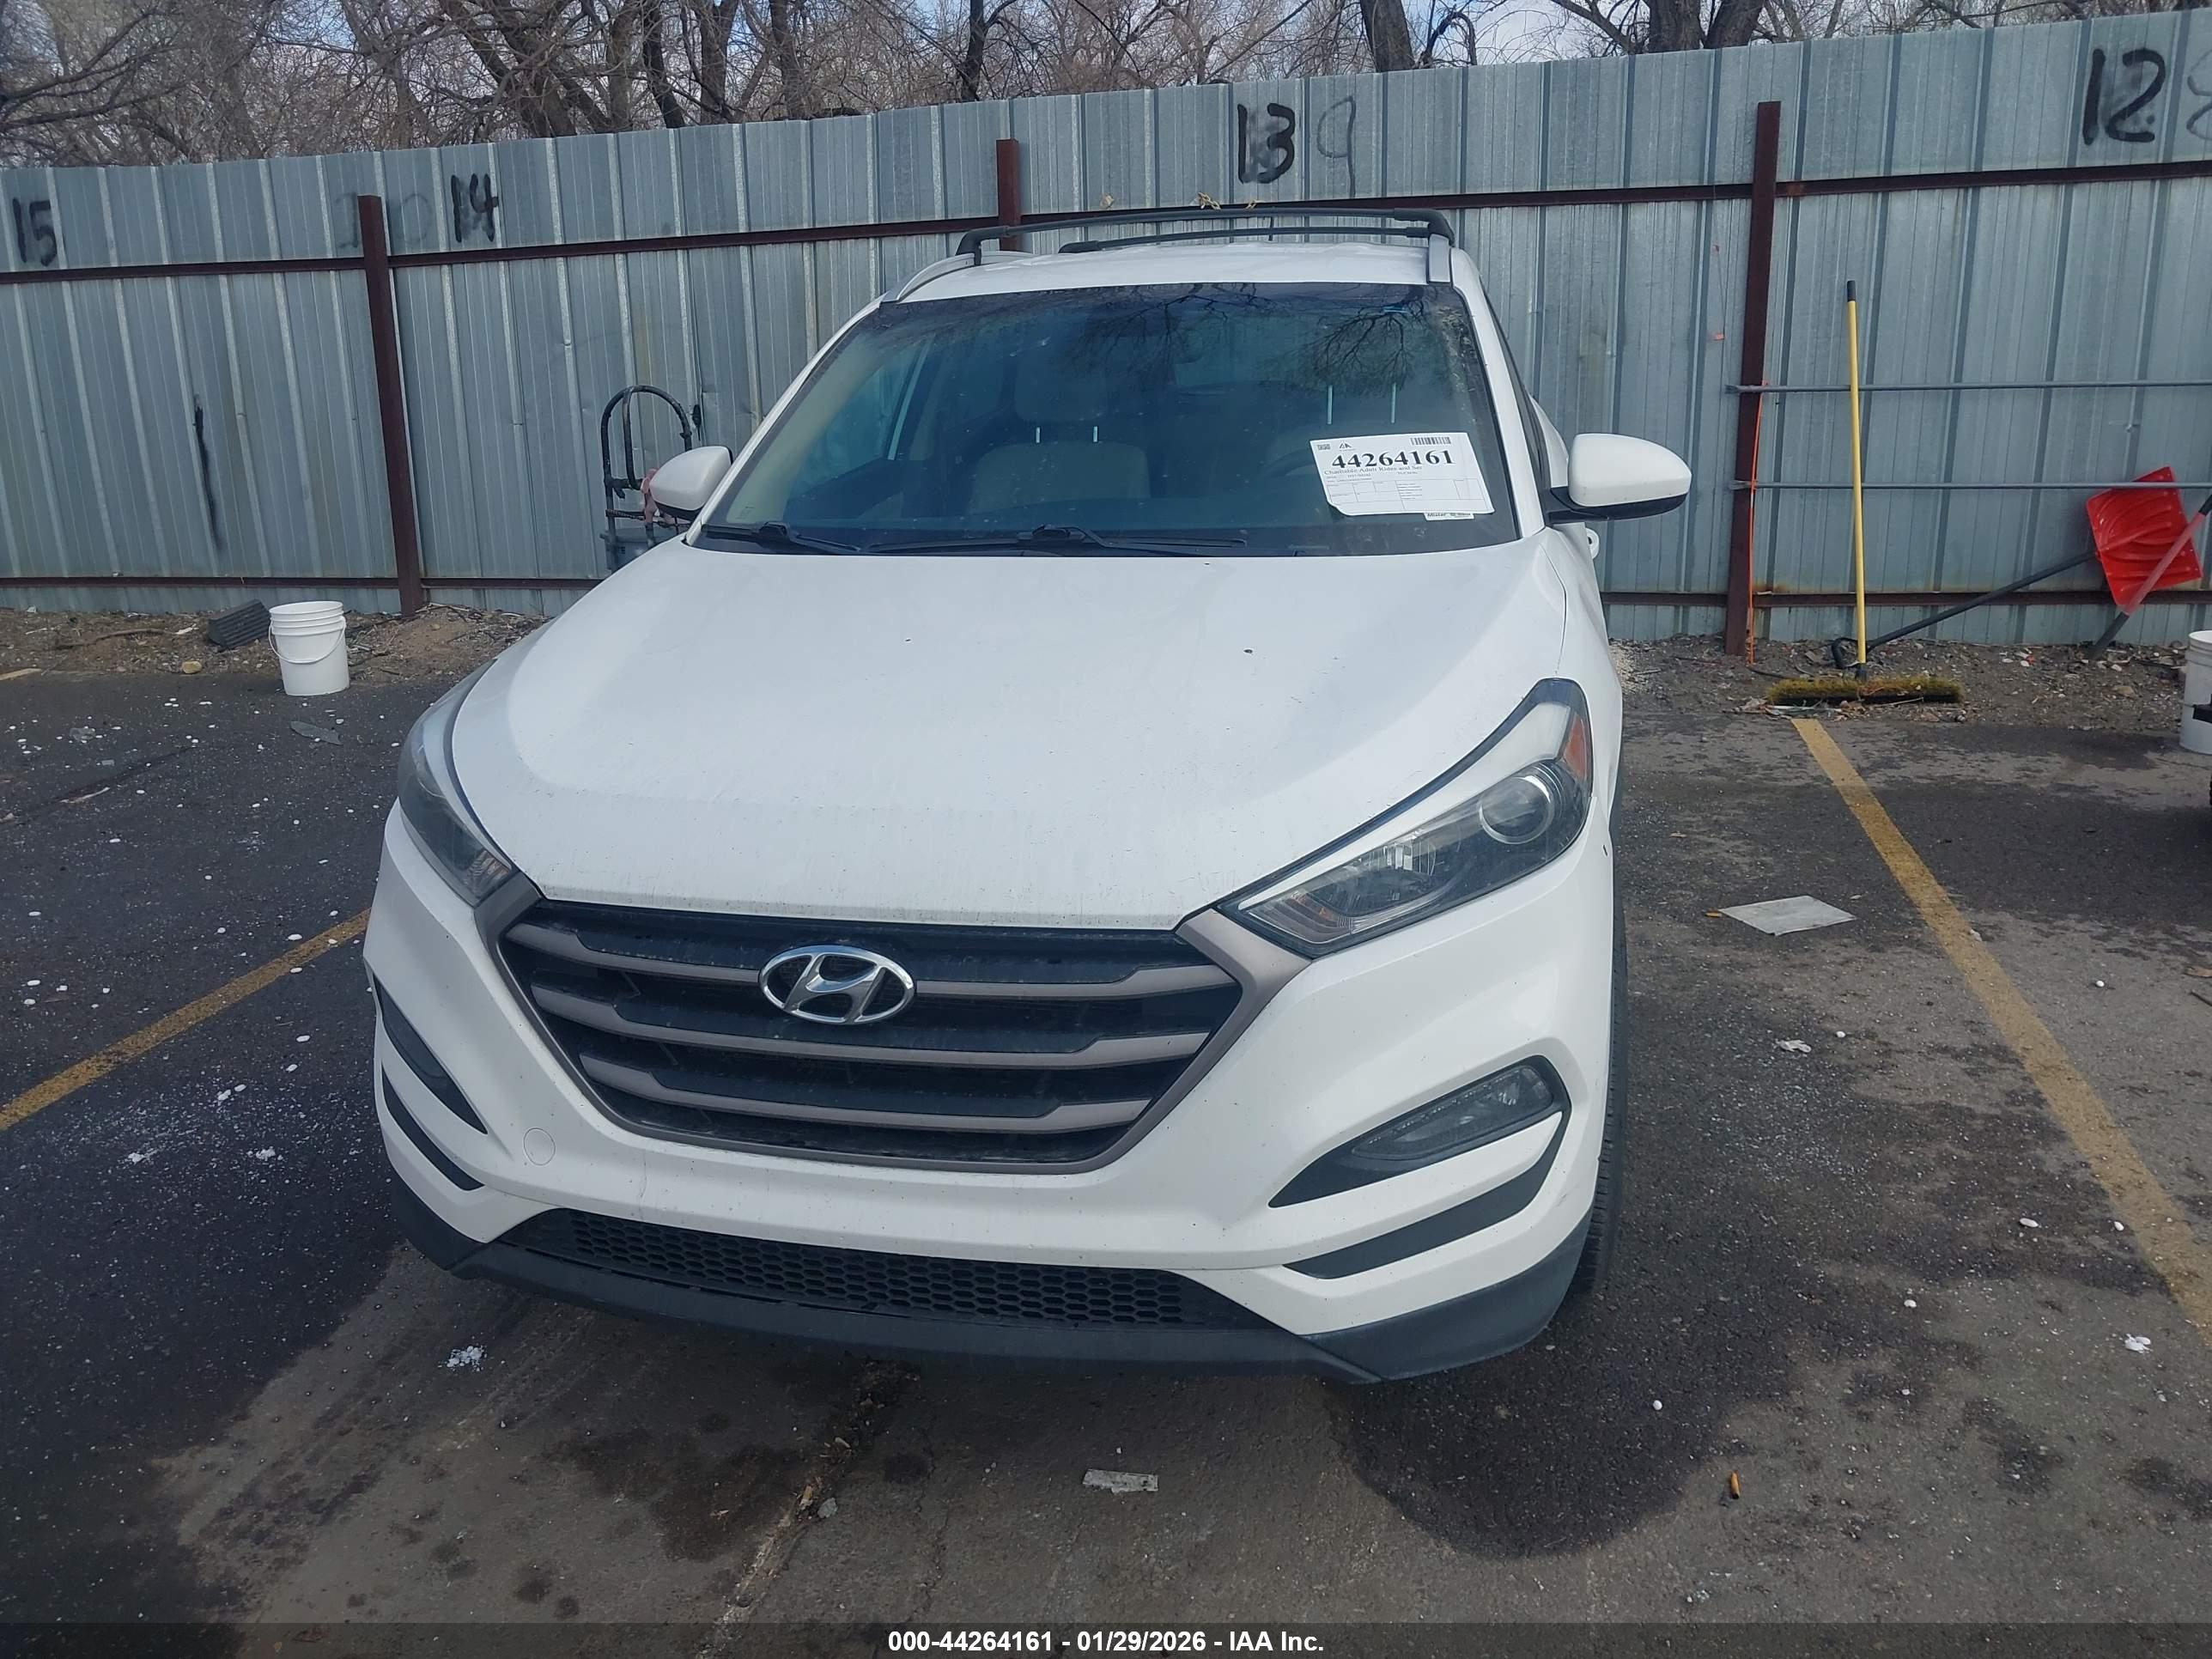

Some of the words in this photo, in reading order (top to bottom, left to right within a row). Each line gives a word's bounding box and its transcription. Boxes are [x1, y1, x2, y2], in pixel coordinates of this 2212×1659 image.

[2082, 47, 2166, 145] 12
[1237, 102, 1296, 184] 13
[12, 197, 58, 267] 15
[451, 173, 499, 242] 14
[1332, 450, 1455, 469] 44264161
